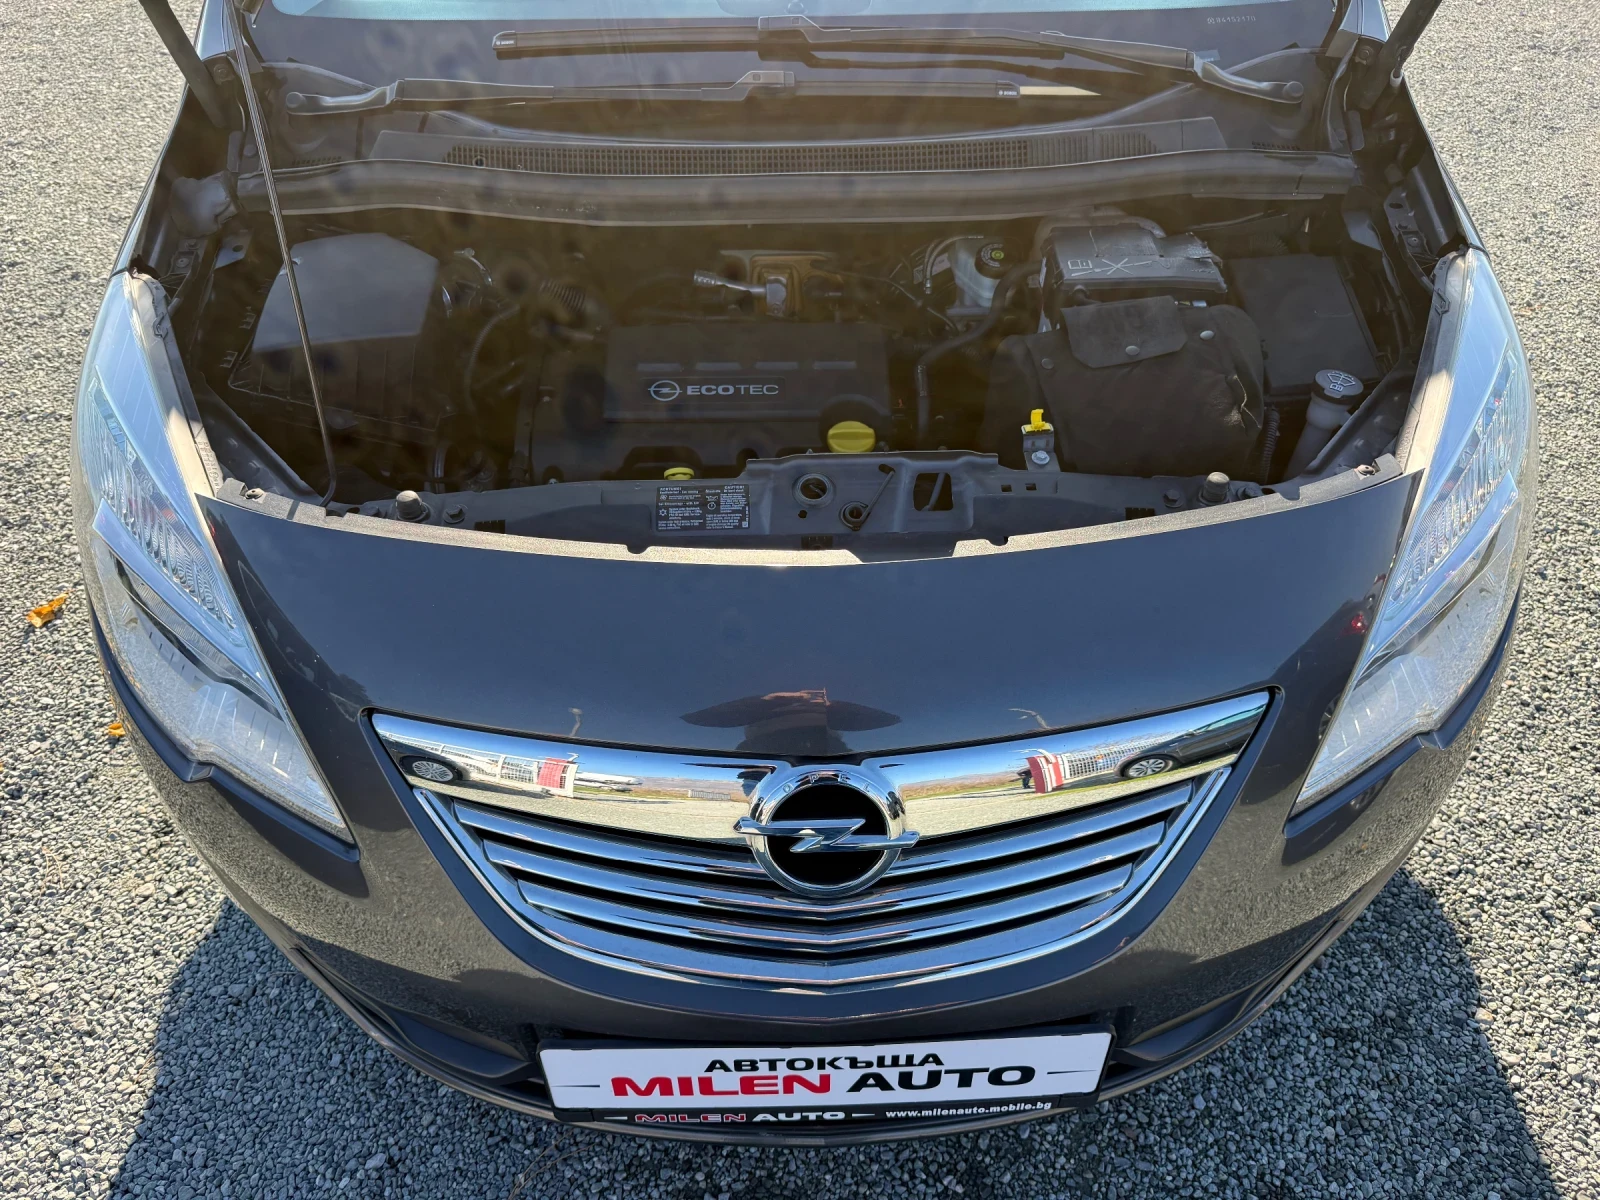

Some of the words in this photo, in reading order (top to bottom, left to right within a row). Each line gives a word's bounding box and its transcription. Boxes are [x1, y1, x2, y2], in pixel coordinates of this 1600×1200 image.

[686, 384, 779, 396] ECOTEC
[782, 773, 871, 793] OPEL
[703, 1052, 945, 1073] АВТОКЪША
[610, 1073, 831, 1097] MILEN
[846, 1065, 1036, 1093] AUTO
[634, 1112, 747, 1123] MILEN
[751, 1111, 846, 1122] AUTO
[885, 1100, 1053, 1118] www.milenauto.mobile.bg
